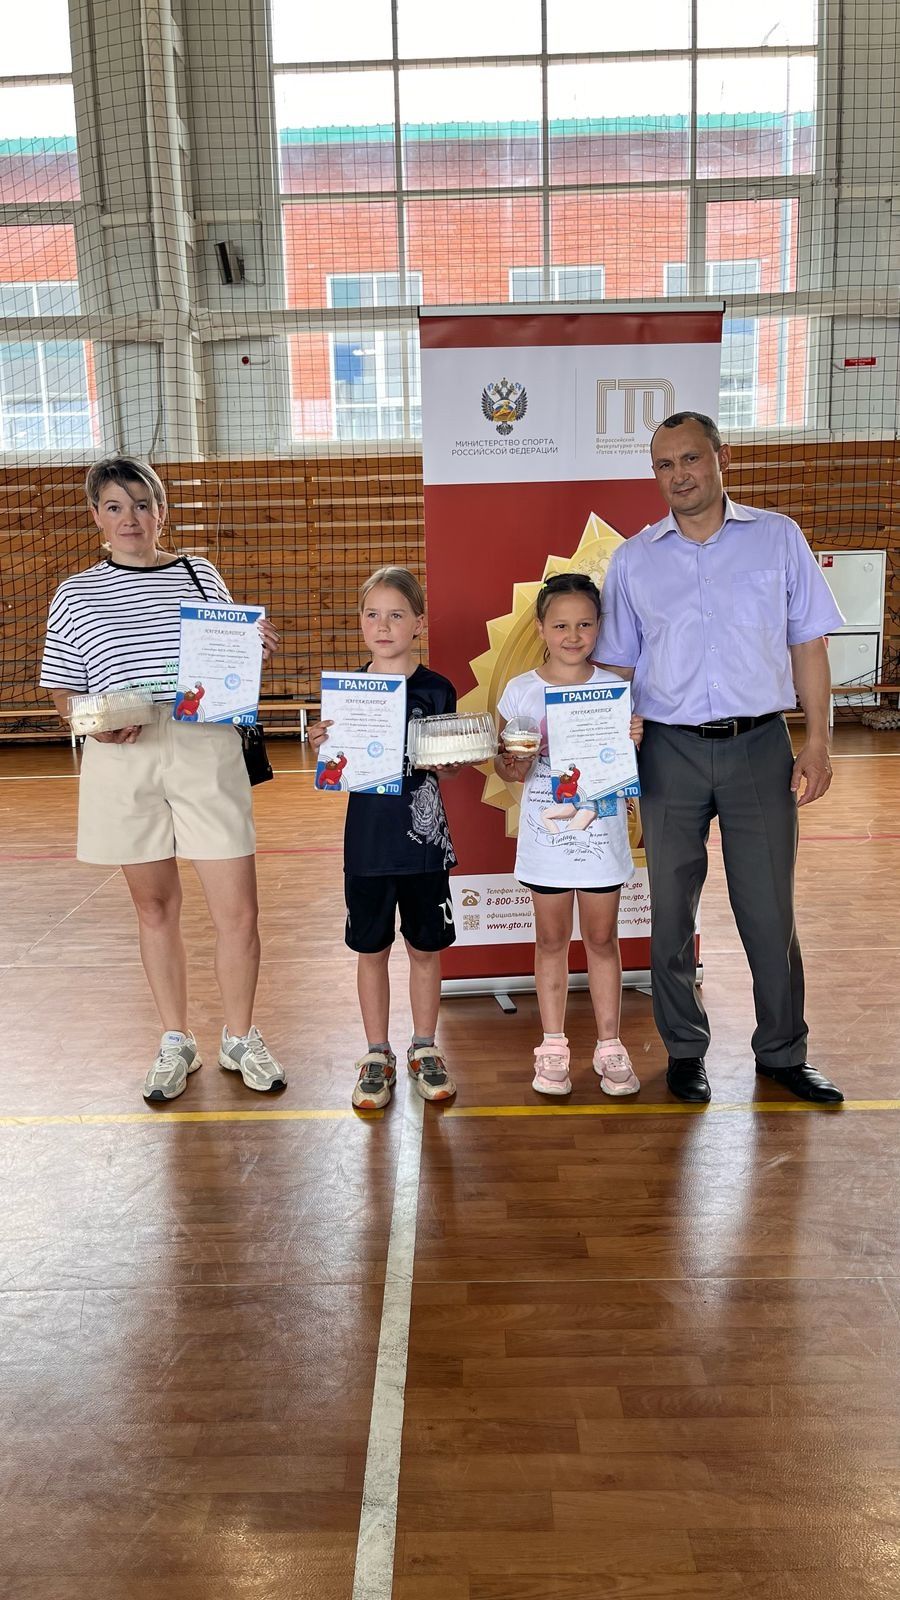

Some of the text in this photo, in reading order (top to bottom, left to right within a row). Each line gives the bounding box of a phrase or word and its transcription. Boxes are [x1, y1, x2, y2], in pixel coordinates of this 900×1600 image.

[597, 378, 675, 434] ГТО
[455, 438, 555, 447] МИНИСТЕРСТВО СПОРТА
[451, 446, 559, 456] РОССИЙСКОЙ ФЕДЕРАЦИИ
[197, 609, 248, 622] ГРАМОТА
[338, 679, 389, 691] ГРАМОТА
[562, 689, 613, 702] ГРАМОТА
[241, 714, 254, 723] ГТО
[386, 783, 399, 793] ГТО
[624, 786, 639, 796] ГТО
[486, 911, 532, 919] официальный
[486, 921, 533, 931] www.gto.ru
